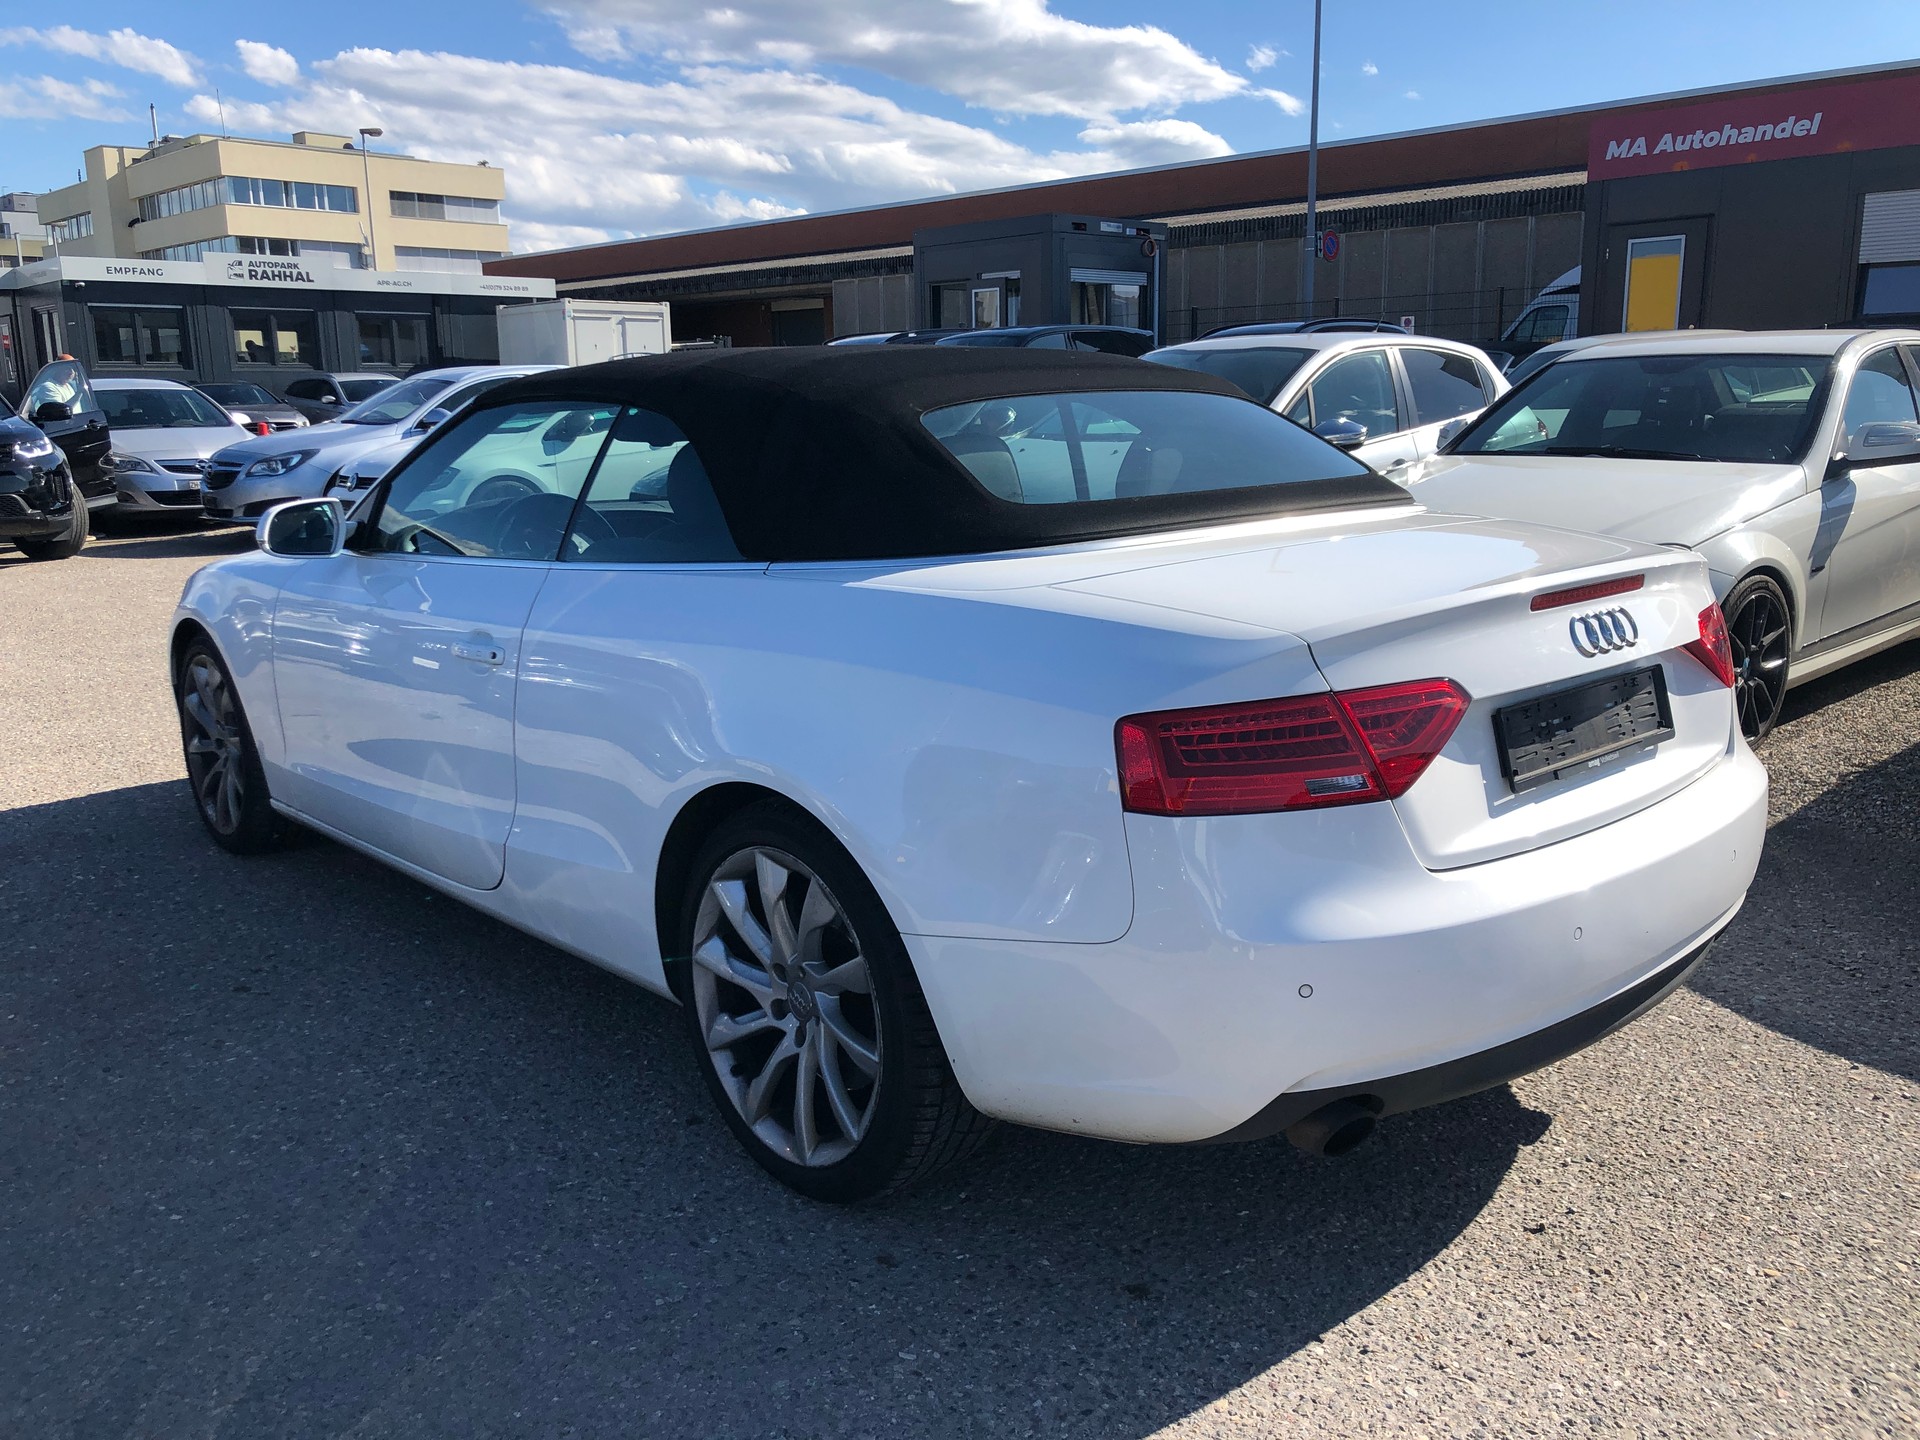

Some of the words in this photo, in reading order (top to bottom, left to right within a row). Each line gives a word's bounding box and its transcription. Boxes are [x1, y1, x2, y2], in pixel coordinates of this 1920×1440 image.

[1605, 136, 1647, 160] MA
[1653, 112, 1823, 154] Autohandel
[248, 260, 300, 270] AUTOPARK
[106, 266, 164, 277] EMPFANG
[248, 269, 315, 283] RAHHAL
